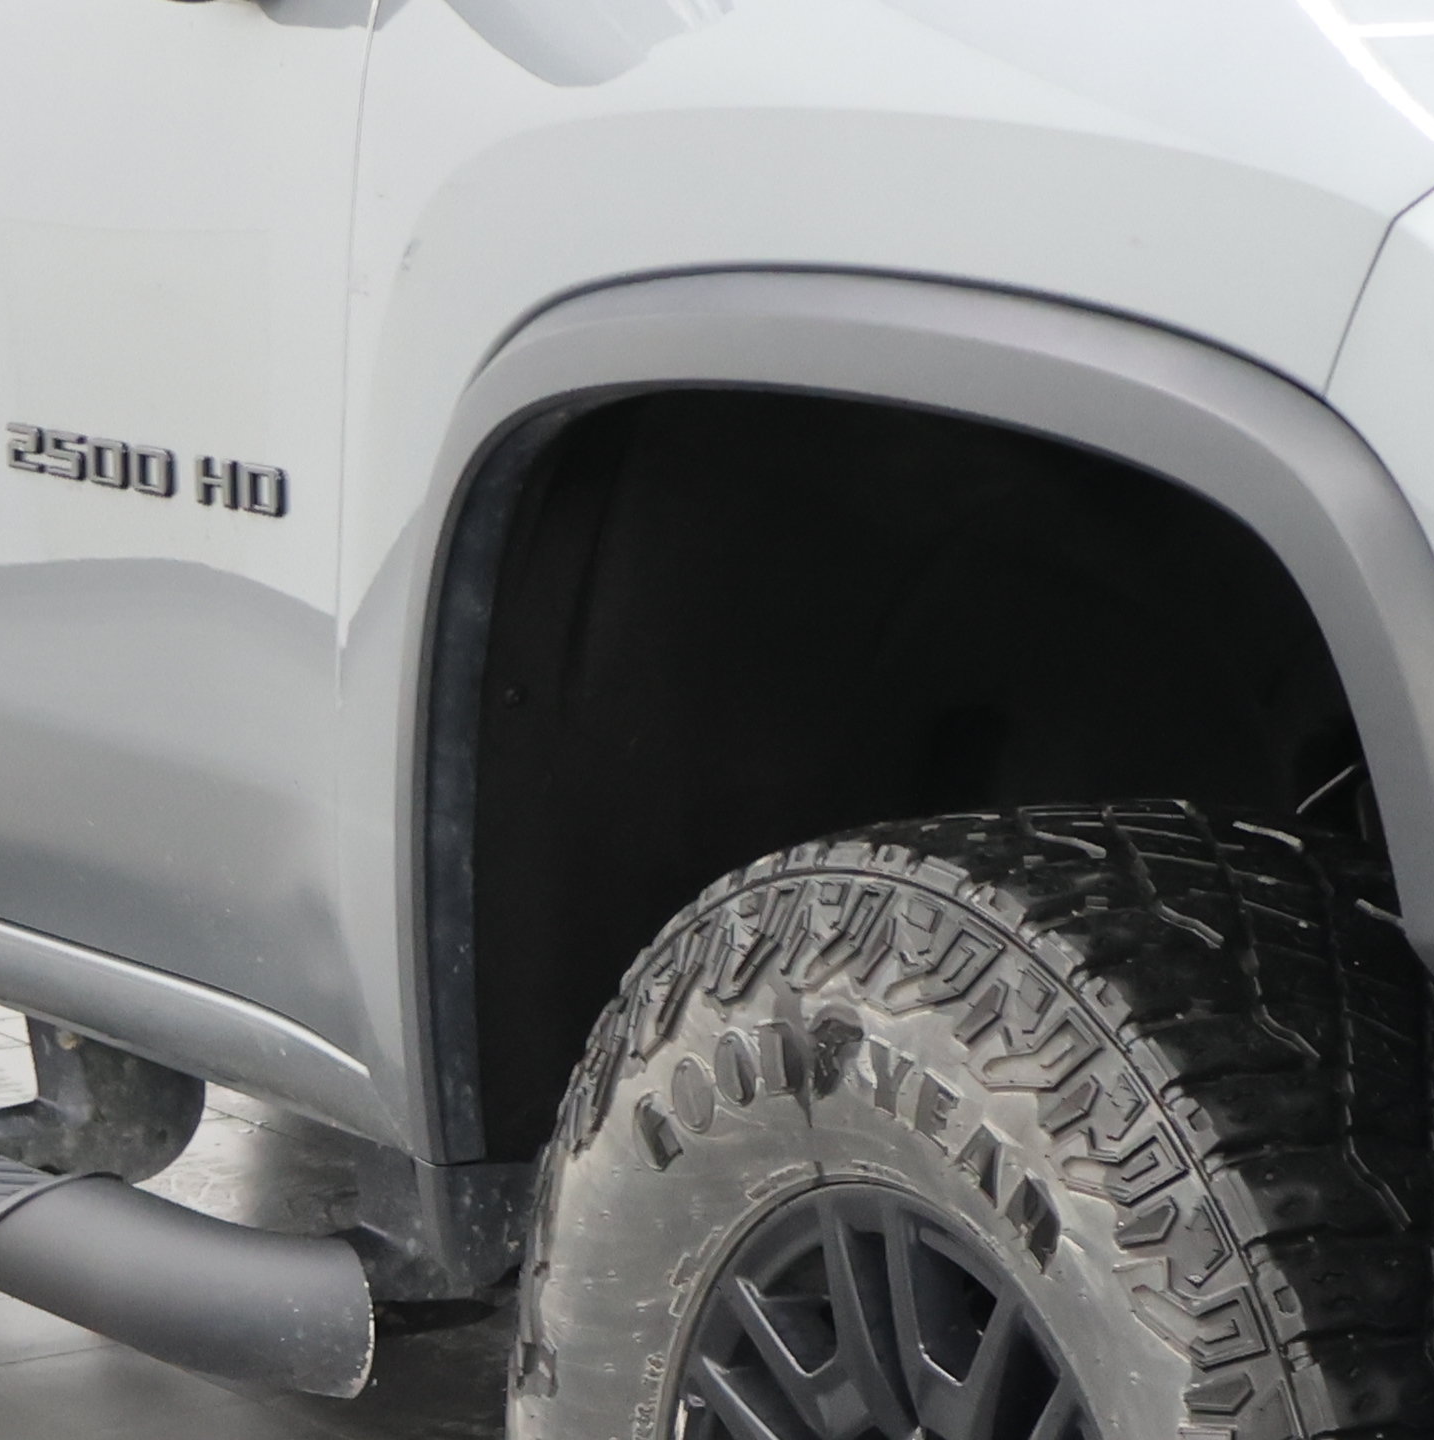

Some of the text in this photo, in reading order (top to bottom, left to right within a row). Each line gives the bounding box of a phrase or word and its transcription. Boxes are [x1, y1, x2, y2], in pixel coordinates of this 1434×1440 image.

[6, 421, 288, 518] 2500 HD
[632, 1016, 1064, 1276] GOODYEAR
